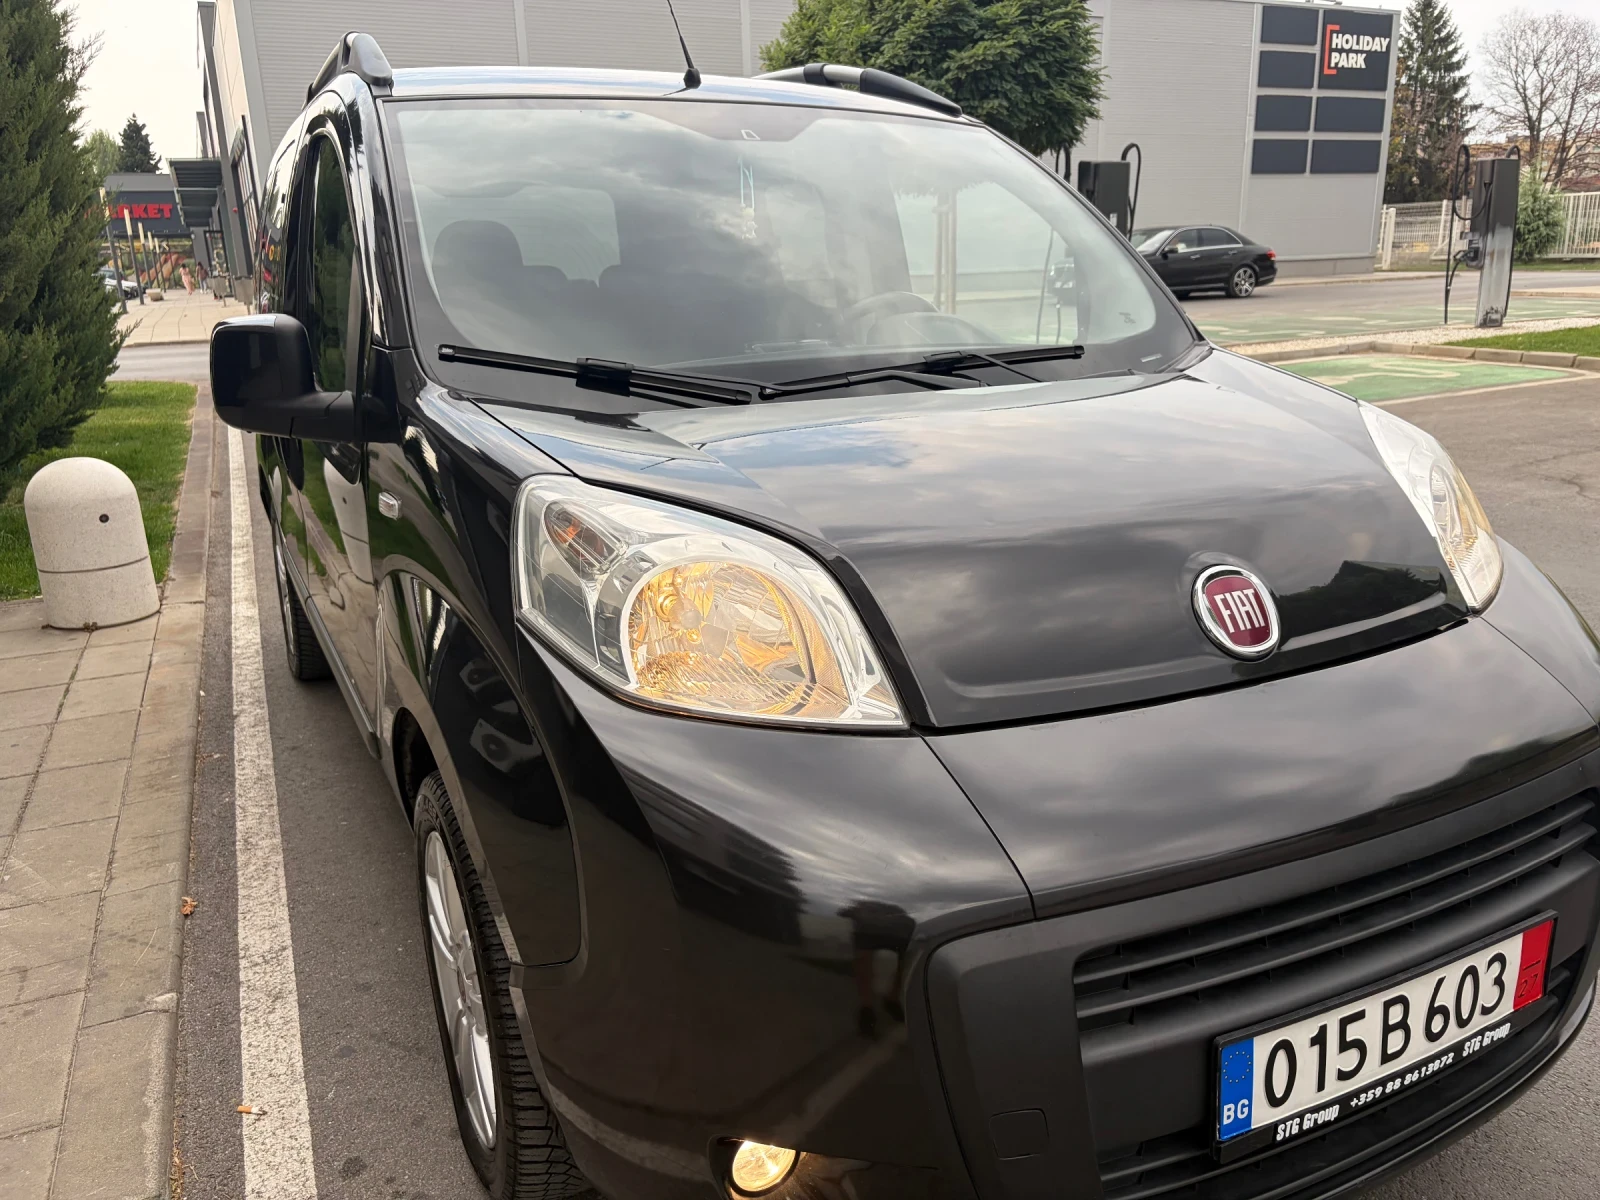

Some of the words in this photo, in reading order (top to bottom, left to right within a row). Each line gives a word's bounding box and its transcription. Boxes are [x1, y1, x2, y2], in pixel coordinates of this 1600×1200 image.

[1330, 52, 1367, 69] PARK
[1331, 33, 1390, 51] HOLIDAY
[1213, 588, 1266, 634] FIAT
[1424, 952, 1507, 1043] 603
[1276, 1118, 1300, 1141] STG
[1302, 1104, 1340, 1130] Group
[1350, 1086, 1383, 1108] +359
[1385, 1078, 1402, 1094] 88
[1462, 1035, 1482, 1057] STG
[1482, 1022, 1511, 1047] Group
[1222, 1098, 1249, 1126] BG
